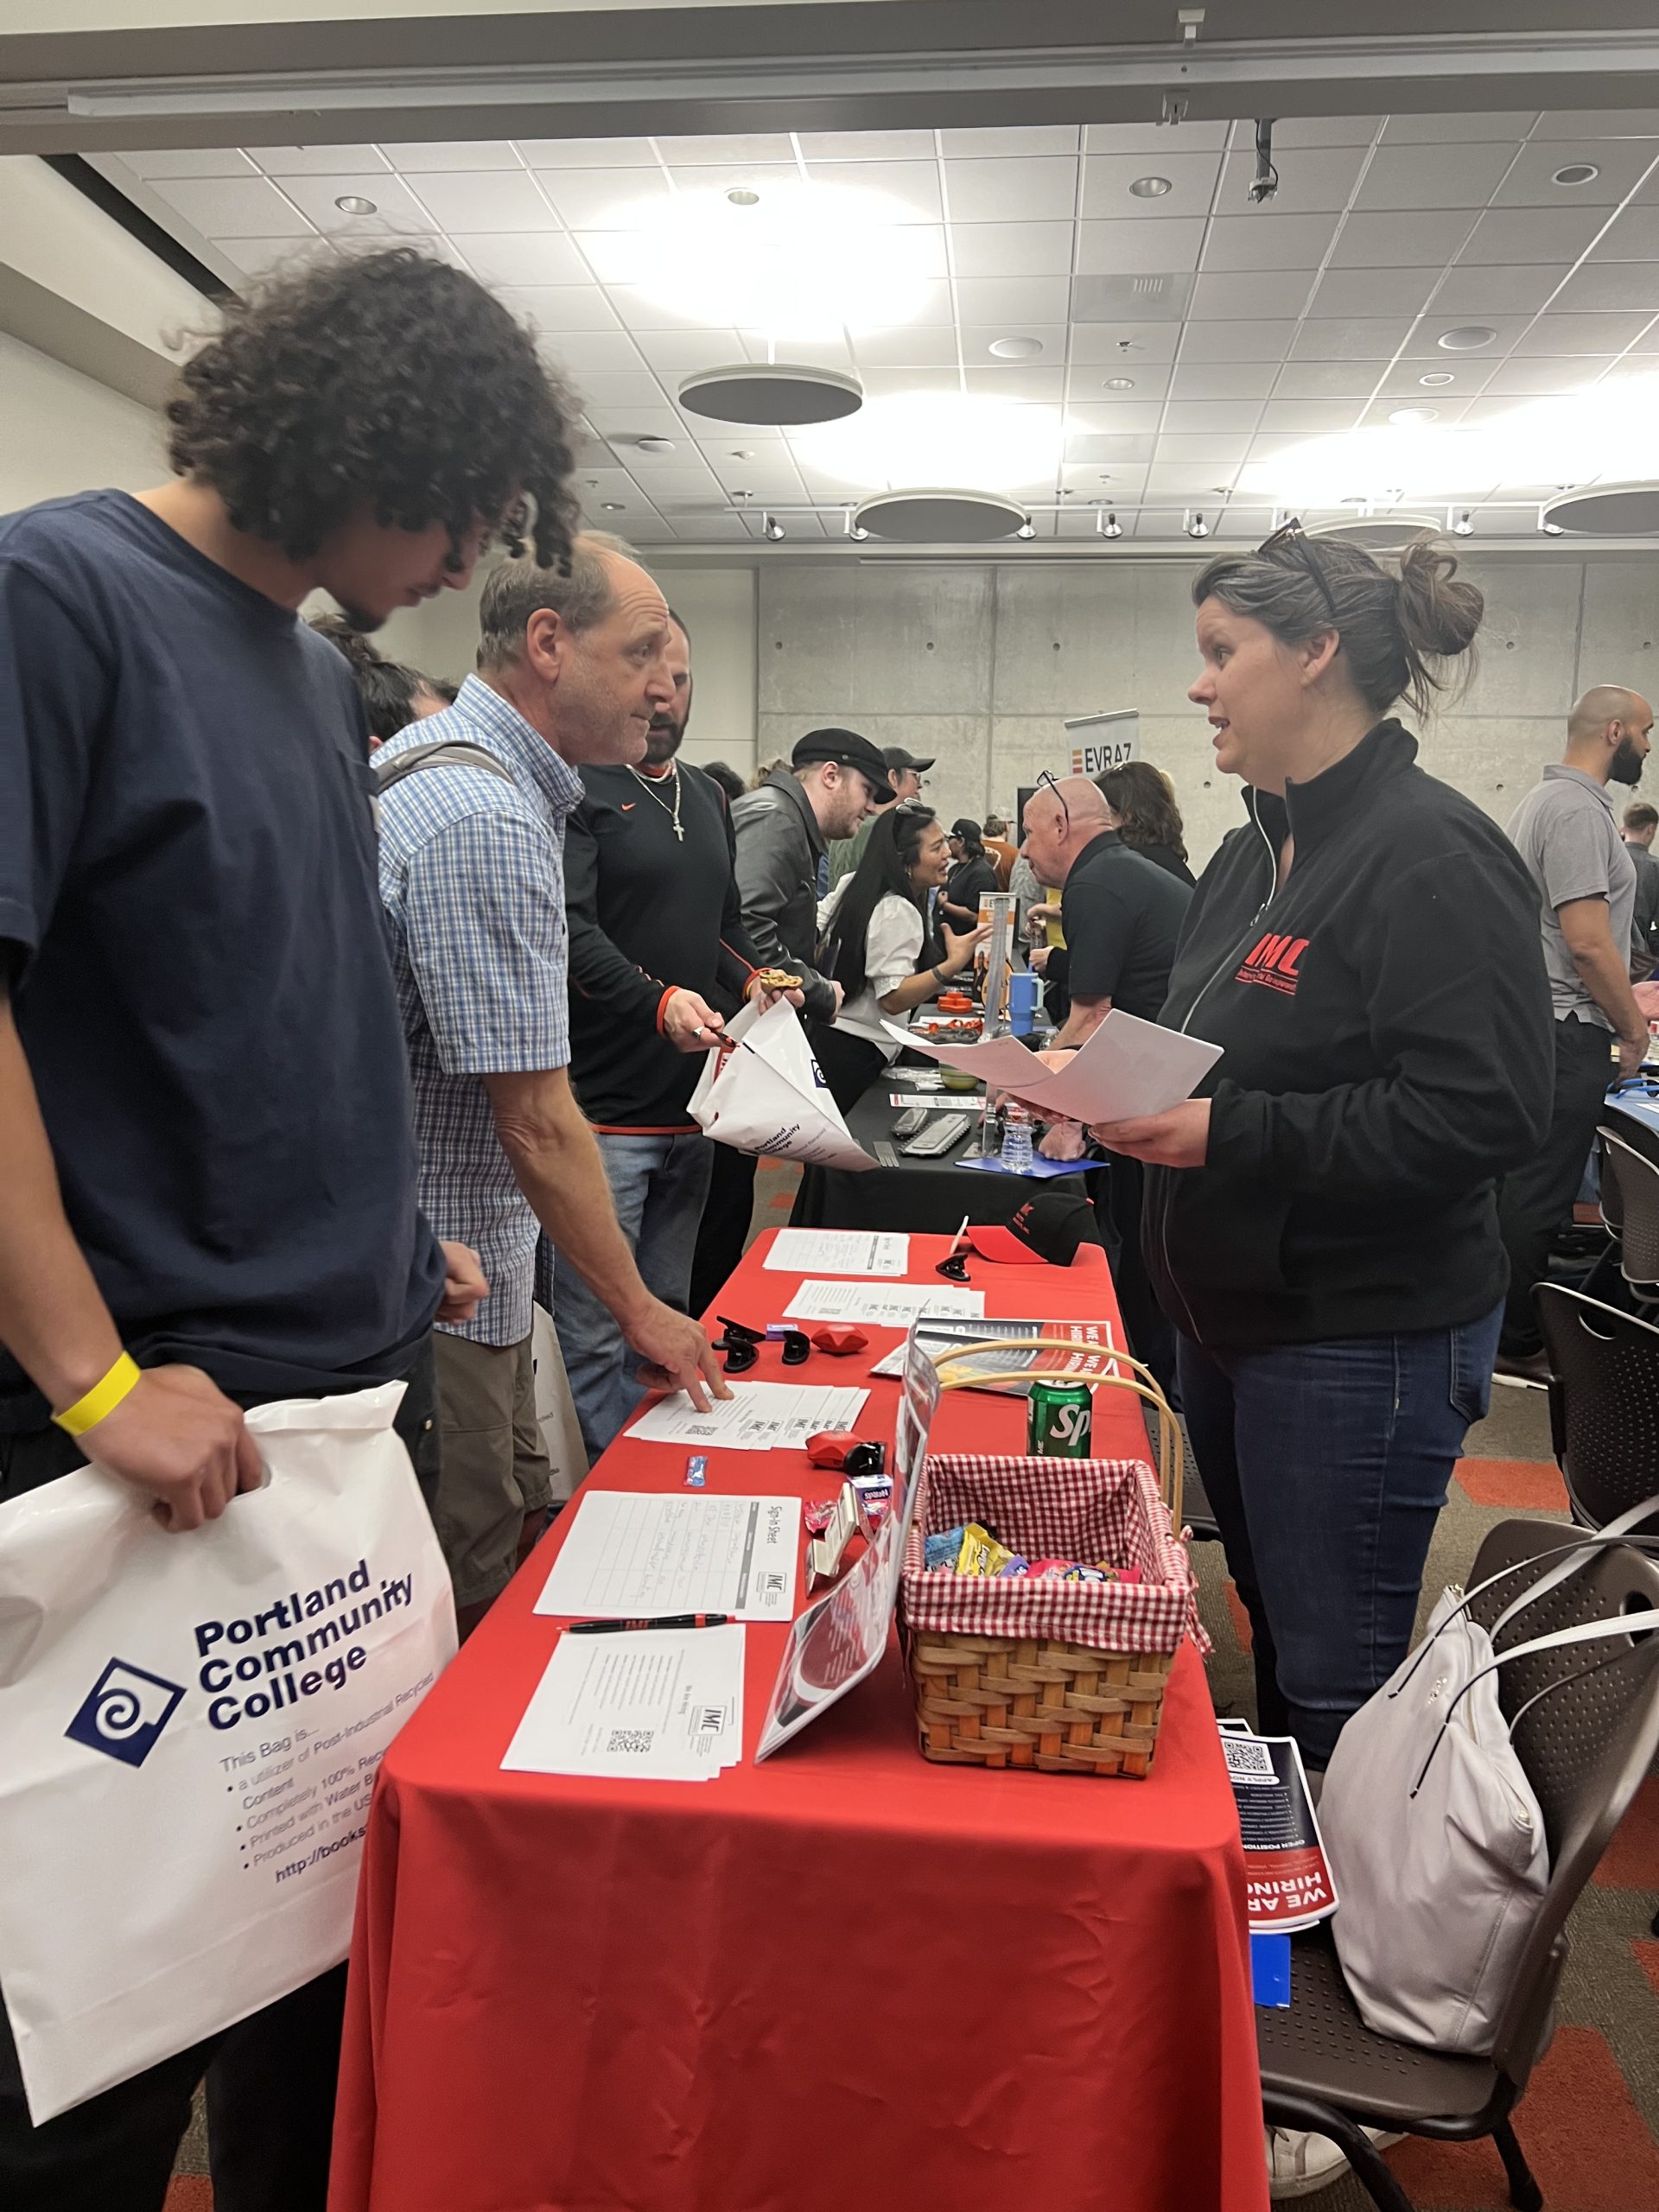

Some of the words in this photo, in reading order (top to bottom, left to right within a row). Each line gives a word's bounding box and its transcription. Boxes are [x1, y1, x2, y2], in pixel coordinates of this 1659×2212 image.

[1244, 933, 1310, 976] IMC
[1050, 1403, 1092, 1446] Sp
[767, 1526, 781, 1544] Sheet
[766, 1574, 784, 1591] IMC
[194, 1559, 371, 1657] Portland
[199, 1573, 413, 1694] Community
[208, 1646, 367, 1730] College
[701, 1708, 722, 1732] IMC
[219, 1751, 257, 1773] This
[259, 1737, 292, 1759] Bag
[251, 1757, 295, 1786] utilizer
[298, 1747, 310, 1763] of
[314, 1702, 394, 1755] Post-Industrial
[243, 1776, 296, 1811] Content
[247, 1784, 318, 1829] Completely
[321, 1764, 356, 1790] 100%
[358, 1750, 385, 1770] Rec
[250, 1817, 296, 1847] Printed
[298, 1802, 323, 1821] with
[325, 1780, 361, 1807] Water
[364, 1773, 374, 1787] B
[253, 1825, 315, 1866] Produced
[318, 1818, 329, 1832] in
[332, 1807, 352, 1824] the
[353, 1793, 372, 1811] US
[1281, 1839, 1306, 1849] OPEN
[276, 1823, 368, 1884] http://books
[1248, 1872, 1323, 1896] HIRIN
[1248, 1897, 1279, 1912] AR
[1286, 1887, 1328, 1909] WE
